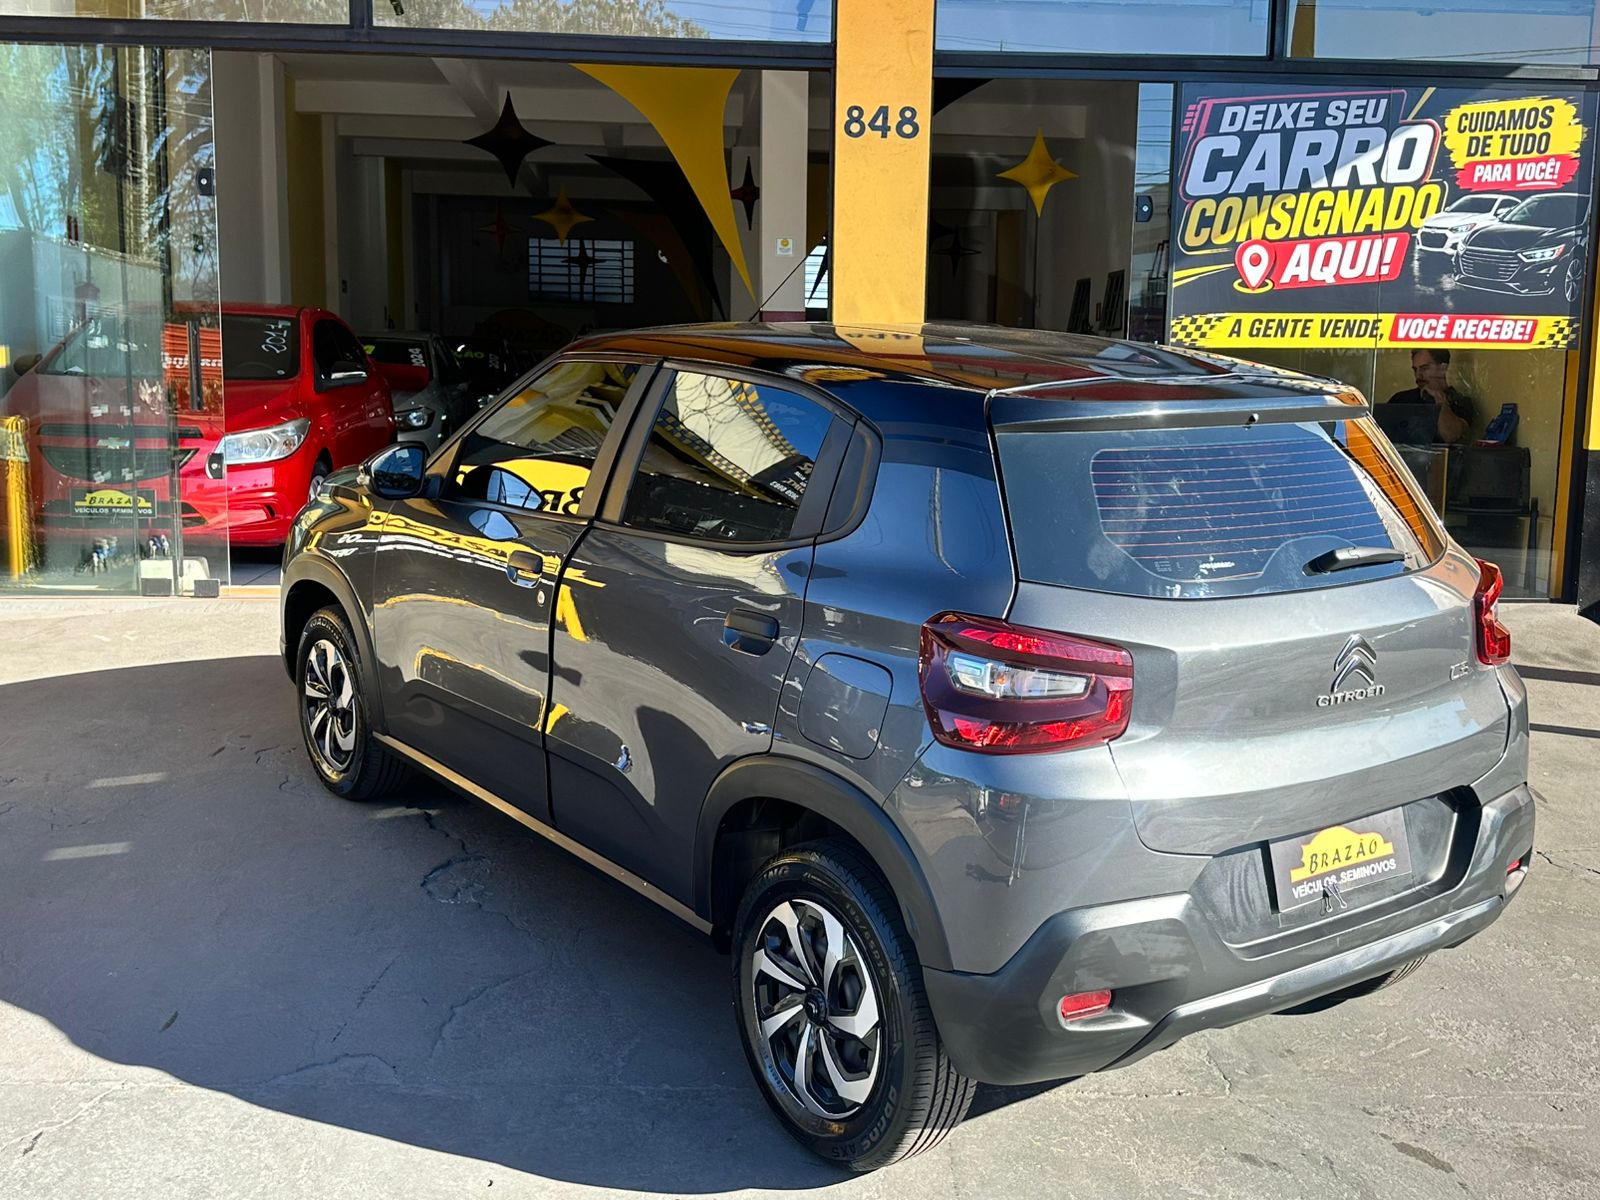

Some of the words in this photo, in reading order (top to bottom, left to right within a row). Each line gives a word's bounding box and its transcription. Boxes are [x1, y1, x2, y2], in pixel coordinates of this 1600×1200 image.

[843, 105, 920, 139] 848
[1218, 102, 1320, 134] DEIXE
[1325, 98, 1388, 126] SEU
[1457, 105, 1555, 134] CUIDAMOS
[1185, 124, 1436, 197] CARRO
[1466, 135, 1493, 157] DE
[1500, 132, 1551, 156] TUDO
[1473, 162, 1512, 183] PARA
[1516, 158, 1561, 181] VOCÊ!
[1184, 183, 1442, 248] CONSIGNADO
[1279, 236, 1399, 284] AQUI!
[1228, 319, 1243, 338] A
[1248, 318, 1317, 339] GENTE
[1319, 318, 1385, 342] VENDE,
[1397, 316, 1450, 341] VOCÊ
[1452, 318, 1535, 343] RECEBE!
[112, 507, 153, 515] SEMINVOS
[1309, 838, 1378, 874] BRAZÃO
[1291, 874, 1338, 899] VEÍCULOS
[1340, 858, 1397, 884] SEMINOVOS
